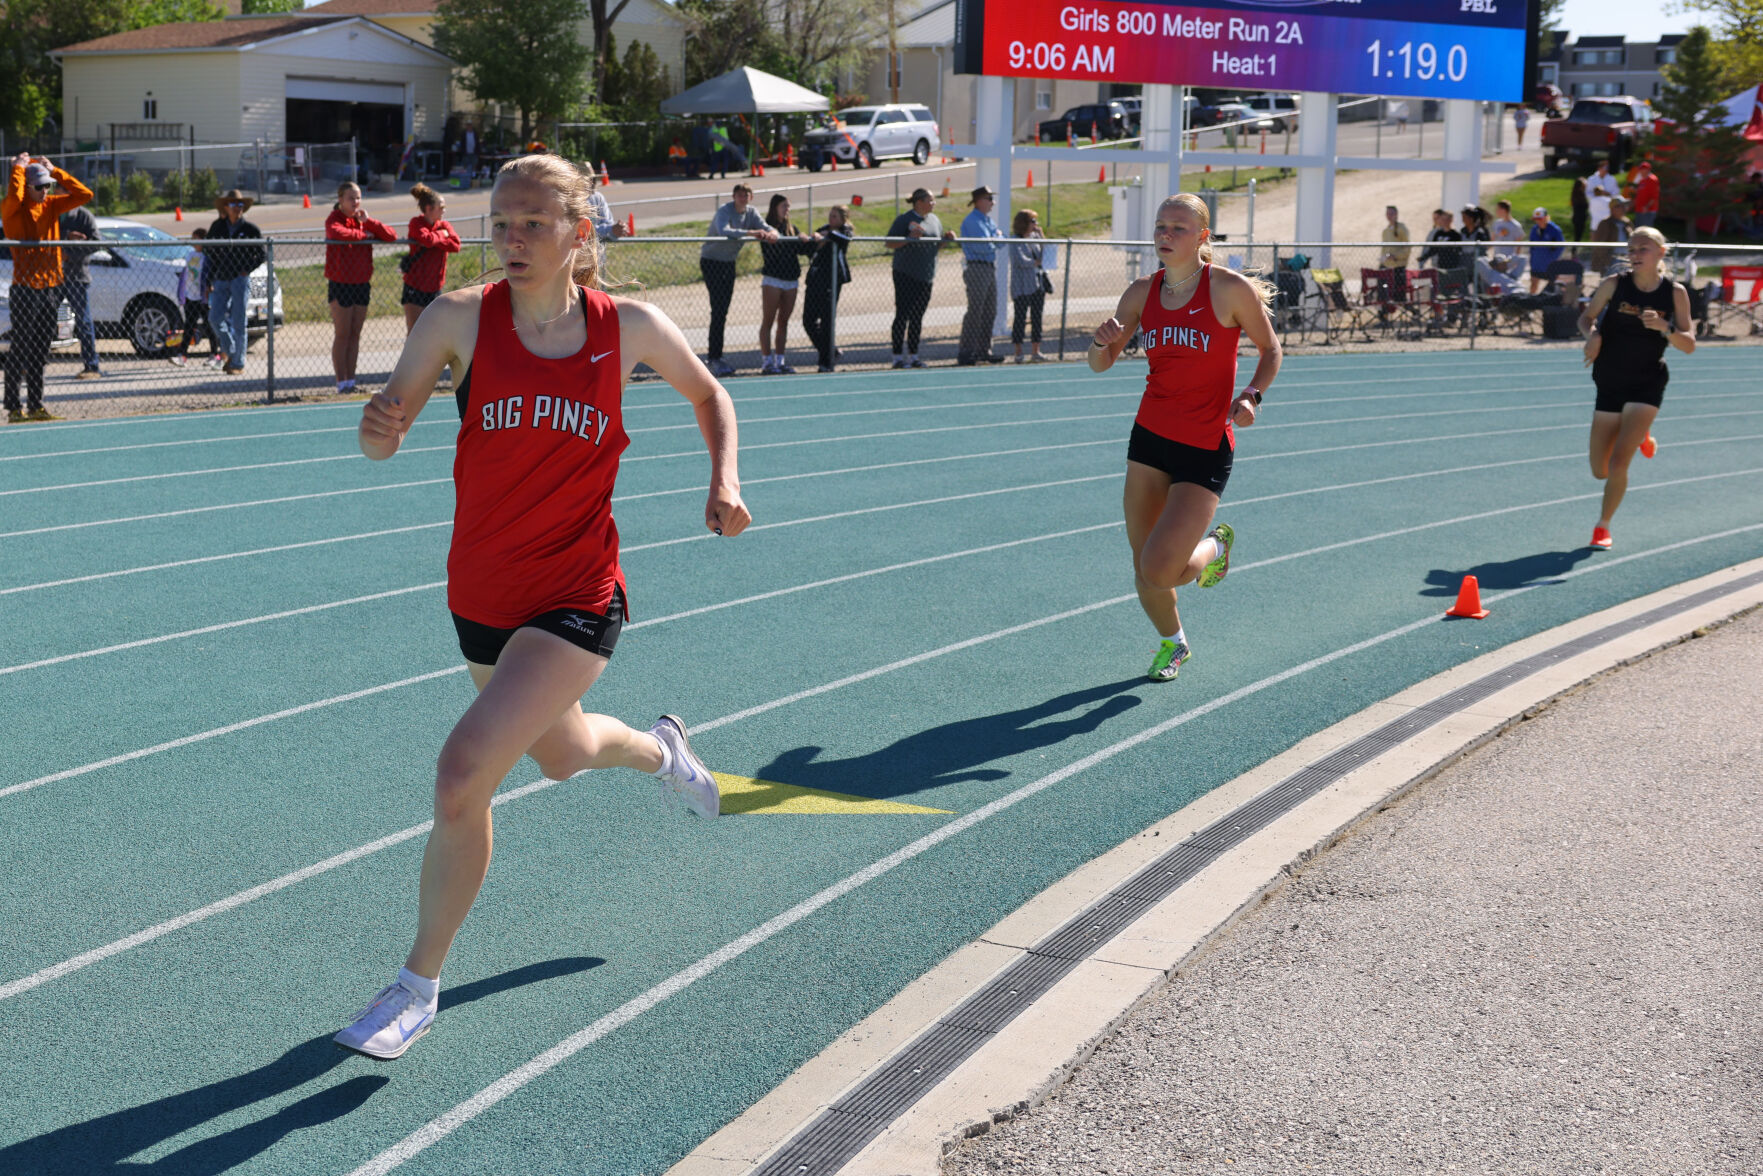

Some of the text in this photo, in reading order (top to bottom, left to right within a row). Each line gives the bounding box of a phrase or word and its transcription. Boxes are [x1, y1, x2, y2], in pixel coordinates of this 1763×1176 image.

[1459, 0, 1497, 13] PBL
[1060, 6, 1304, 45] Girls 800 Meter Run 2A
[1008, 40, 1116, 74] 9:06 AM
[1212, 50, 1277, 76] Heat:1
[1366, 39, 1468, 82] 1:19.0
[1162, 326, 1210, 353] PINEY
[481, 394, 610, 447] BIG PINEY
